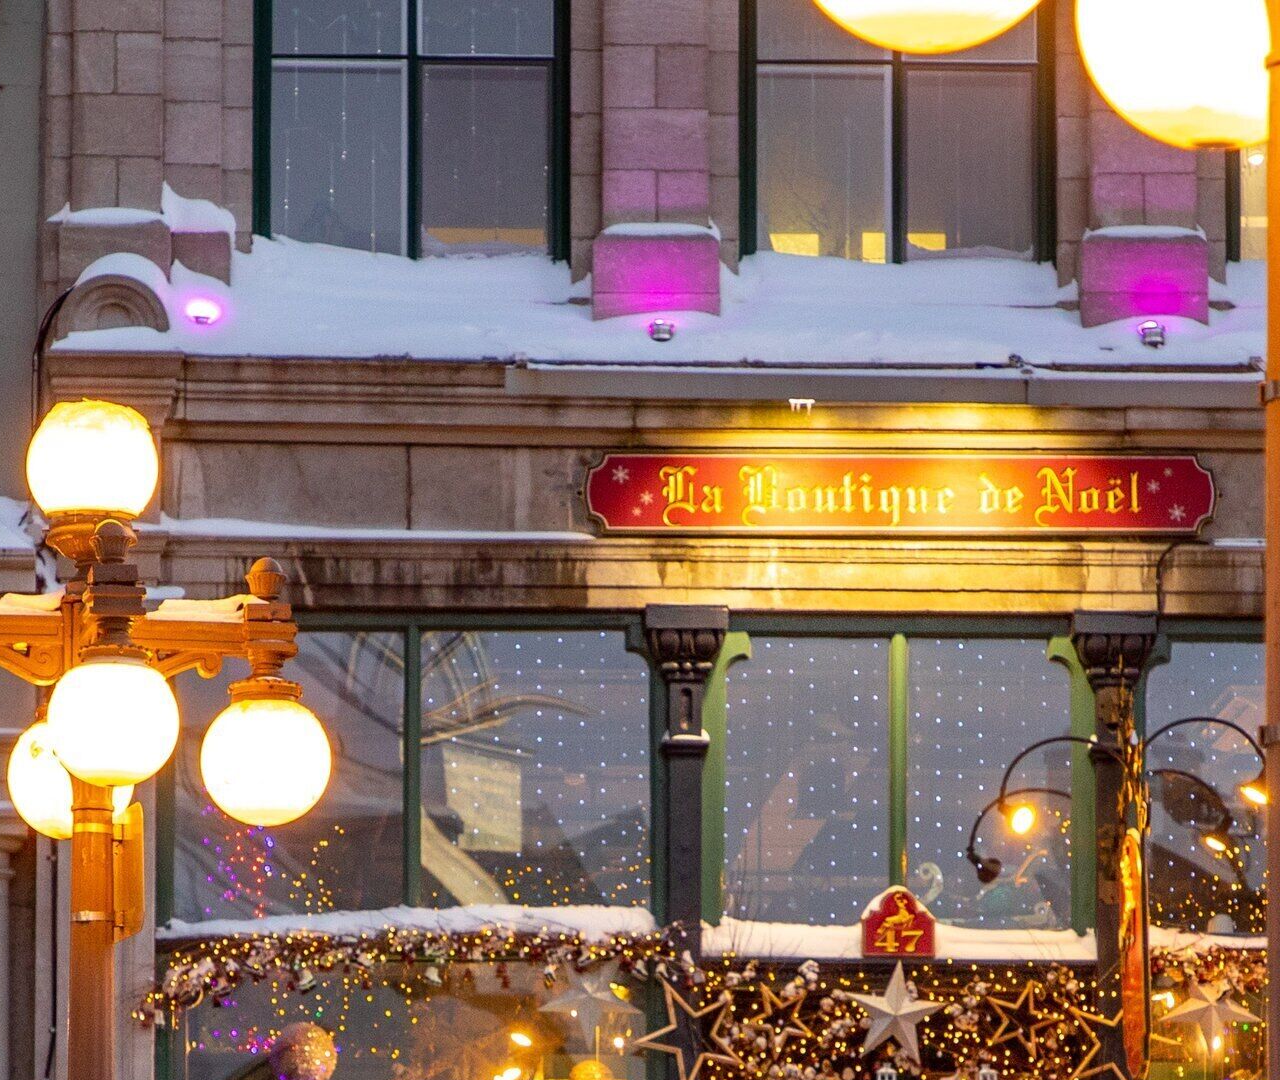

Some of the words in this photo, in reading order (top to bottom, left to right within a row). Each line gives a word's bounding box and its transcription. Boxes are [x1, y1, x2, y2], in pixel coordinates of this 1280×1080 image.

[660, 465, 724, 527] La
[738, 465, 955, 527] Boutique
[978, 472, 1024, 514] de
[1035, 467, 1142, 527] Noël
[874, 930, 924, 954] 47
